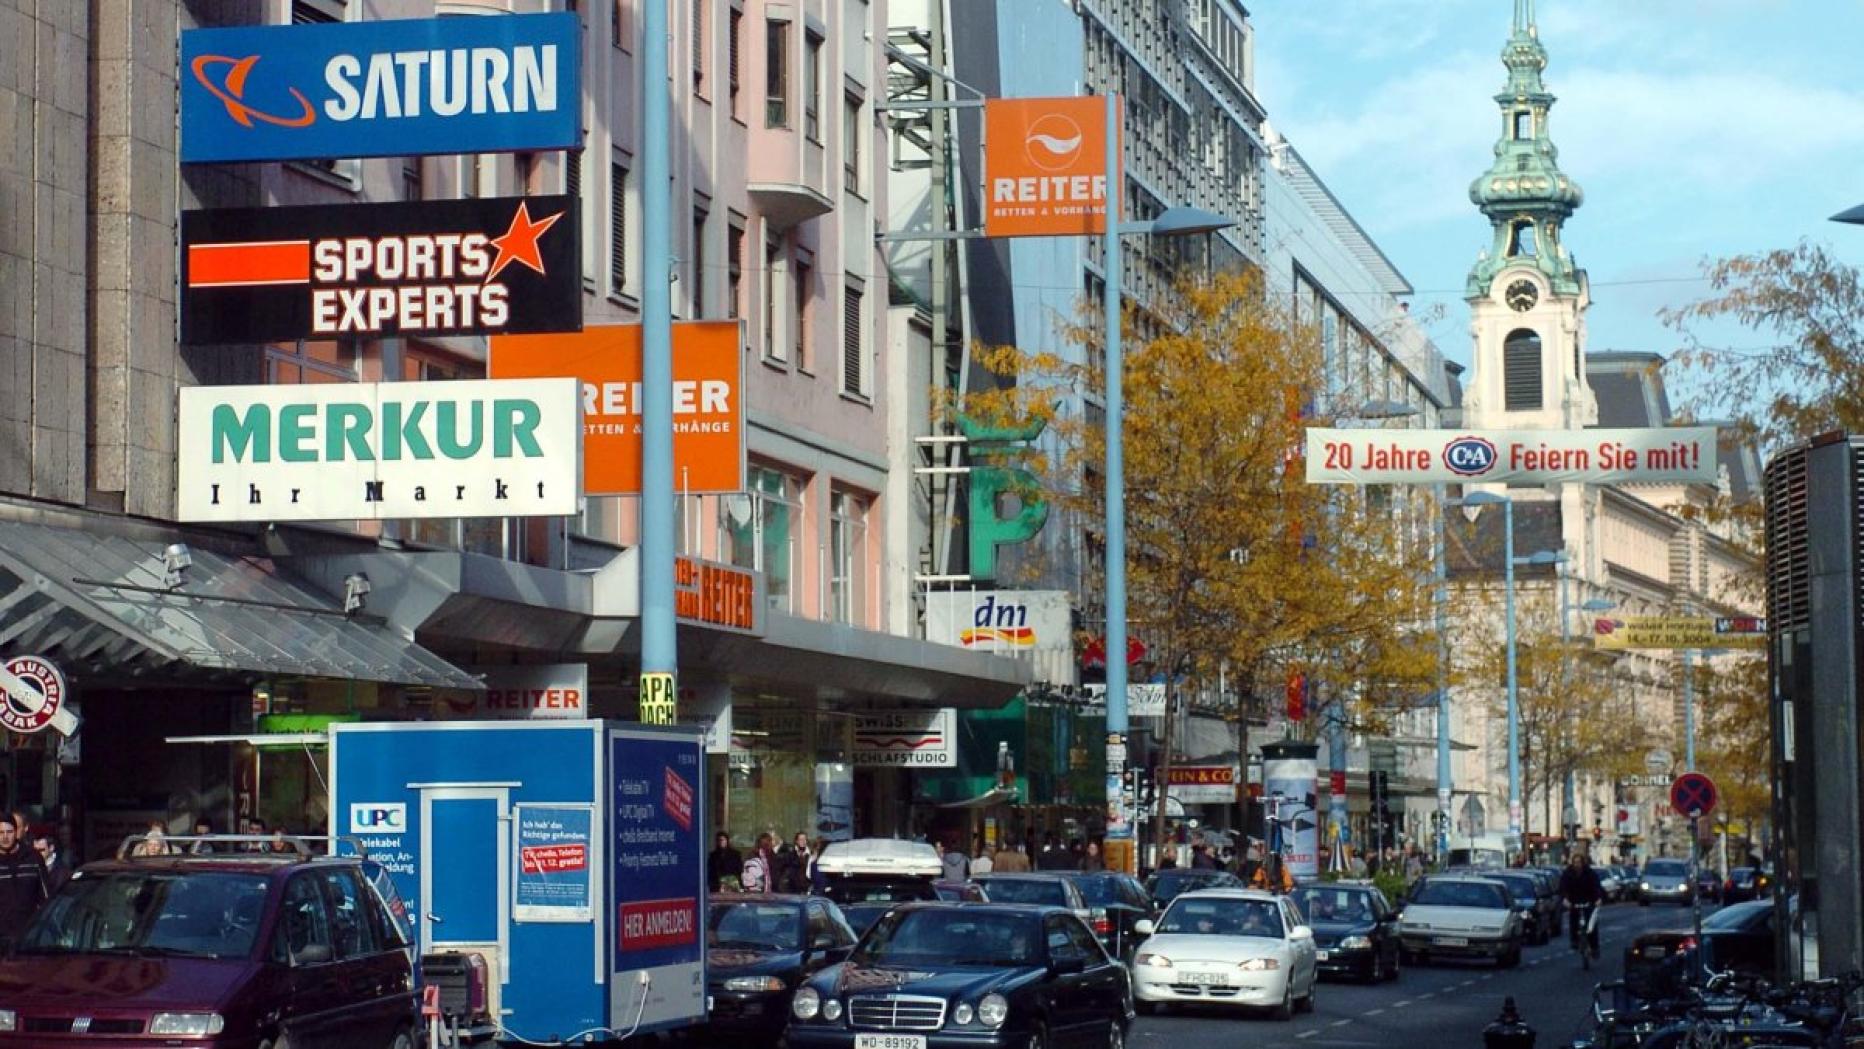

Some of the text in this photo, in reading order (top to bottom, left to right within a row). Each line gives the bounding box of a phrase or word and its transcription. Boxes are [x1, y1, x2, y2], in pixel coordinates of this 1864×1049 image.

[324, 44, 557, 122] SATURN
[993, 176, 1107, 203] REITER
[314, 234, 490, 281] SPORTS
[312, 283, 509, 332] EXPERTS
[583, 380, 730, 415] REIER
[212, 399, 545, 464] MERKUR
[1324, 441, 1699, 471] 20 Jahre C&A Feiern Sie mit!
[211, 478, 545, 505] Ihr Markt
[974, 595, 1027, 628] dm
[487, 689, 580, 709] REITER
[851, 752, 948, 764] SCHLAFSTUDIO
[356, 809, 402, 828] UPC
[623, 908, 692, 939] HIER ANMELDEN!
